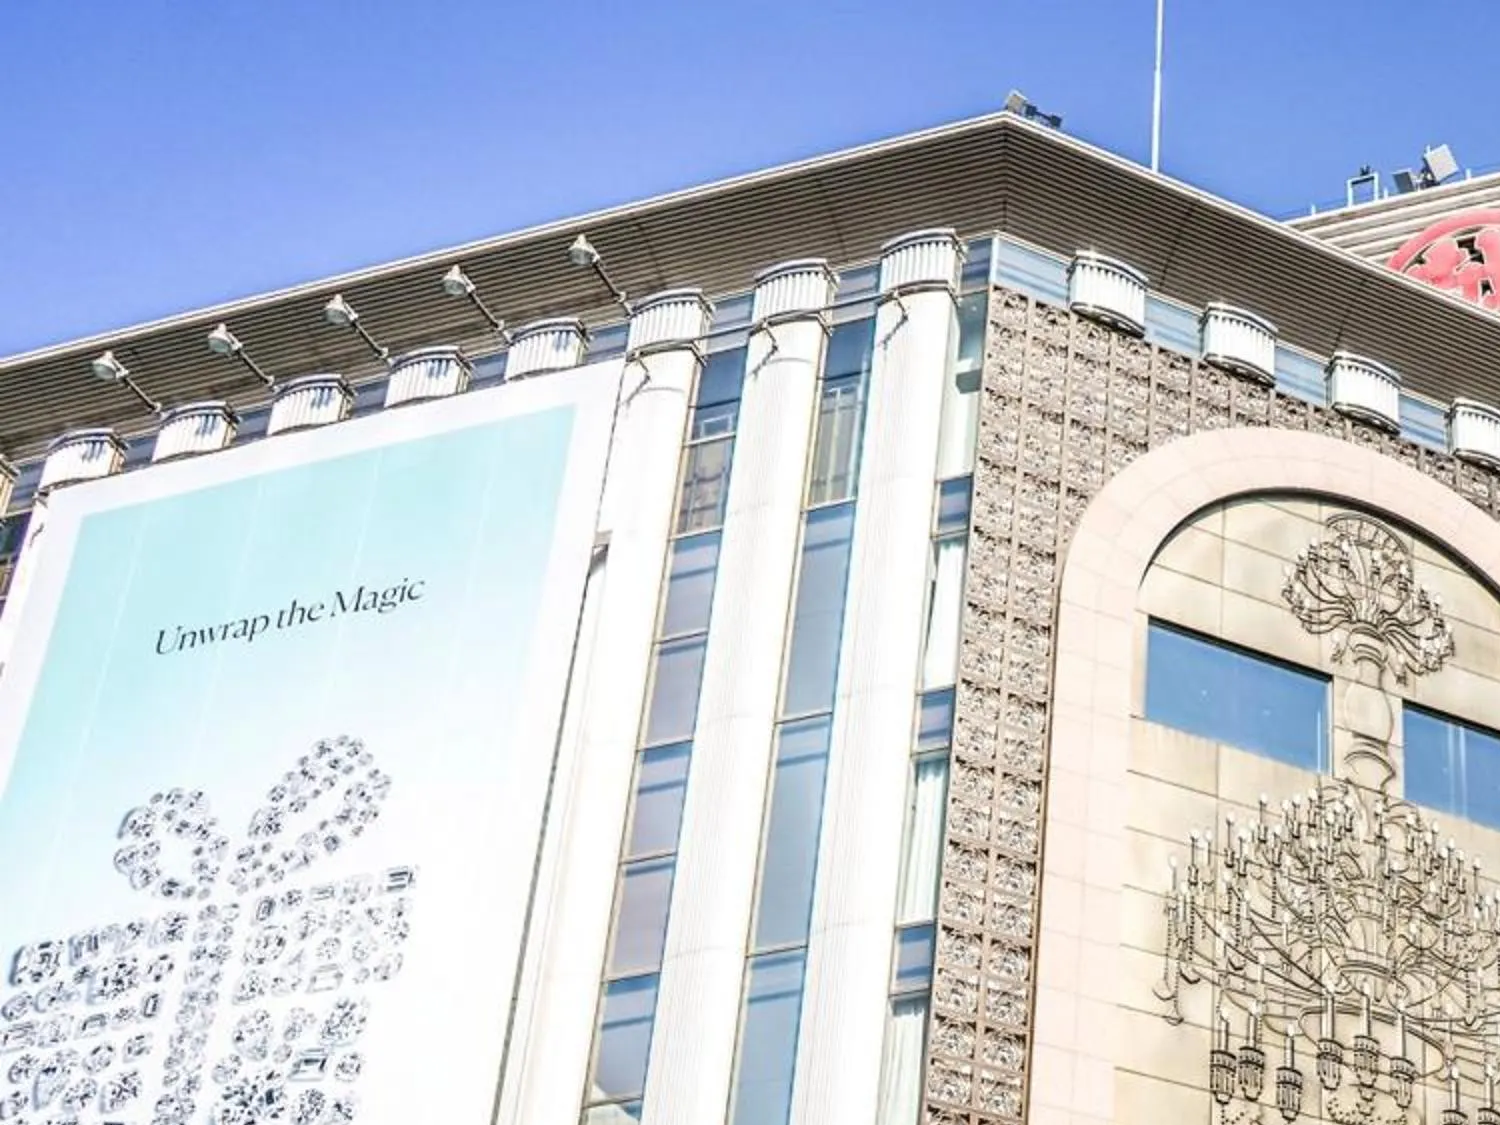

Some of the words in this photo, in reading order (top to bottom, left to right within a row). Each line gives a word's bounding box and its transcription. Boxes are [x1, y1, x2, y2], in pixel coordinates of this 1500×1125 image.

[155, 613, 270, 655] Unwrap
[276, 599, 325, 629] the
[330, 577, 425, 617] Magic
